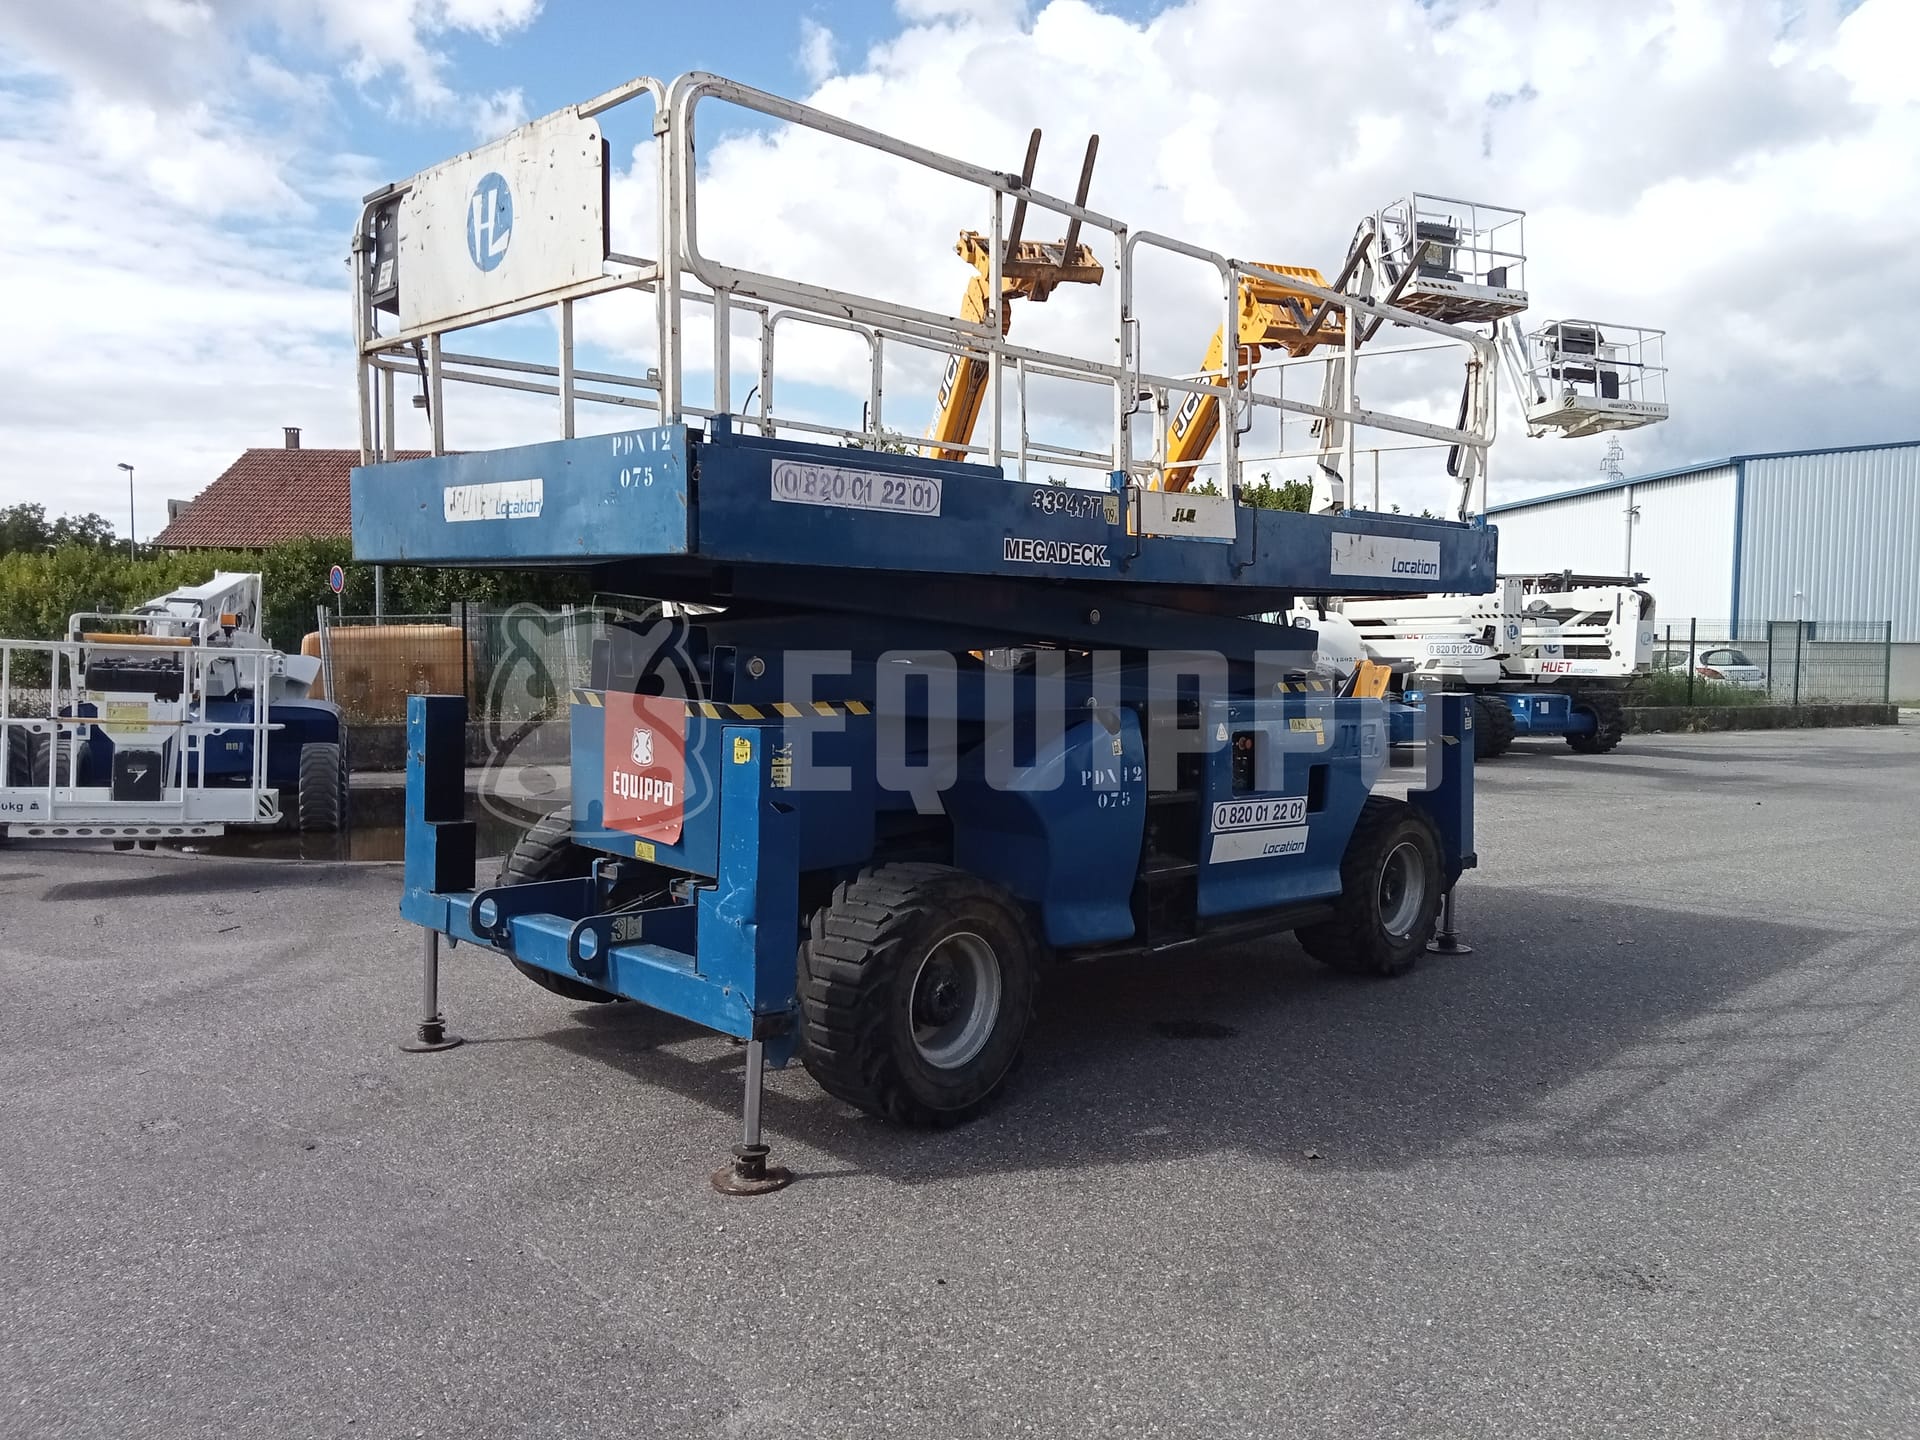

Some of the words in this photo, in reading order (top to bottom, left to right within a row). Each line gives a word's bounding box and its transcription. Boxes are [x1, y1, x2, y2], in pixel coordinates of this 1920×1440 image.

[939, 352, 959, 411] JC
[620, 466, 654, 488] 075
[852, 477, 872, 500] 01
[881, 480, 906, 505] 22
[913, 484, 932, 507] 01
[1004, 538, 1107, 567] MEGADECK
[1392, 557, 1437, 575] Location
[1436, 645, 1450, 654] 820
[1451, 645, 1460, 654] 01
[1462, 645, 1473, 654] 22
[1474, 645, 1483, 654] 01
[1541, 661, 1573, 673] HUET
[1098, 791, 1130, 808] 075
[1219, 807, 1227, 825] 0
[1229, 805, 1253, 824] 820
[1255, 804, 1269, 821] 01
[1272, 803, 1288, 821] 22
[1290, 802, 1303, 819] 01
[1262, 840, 1305, 855] Location
